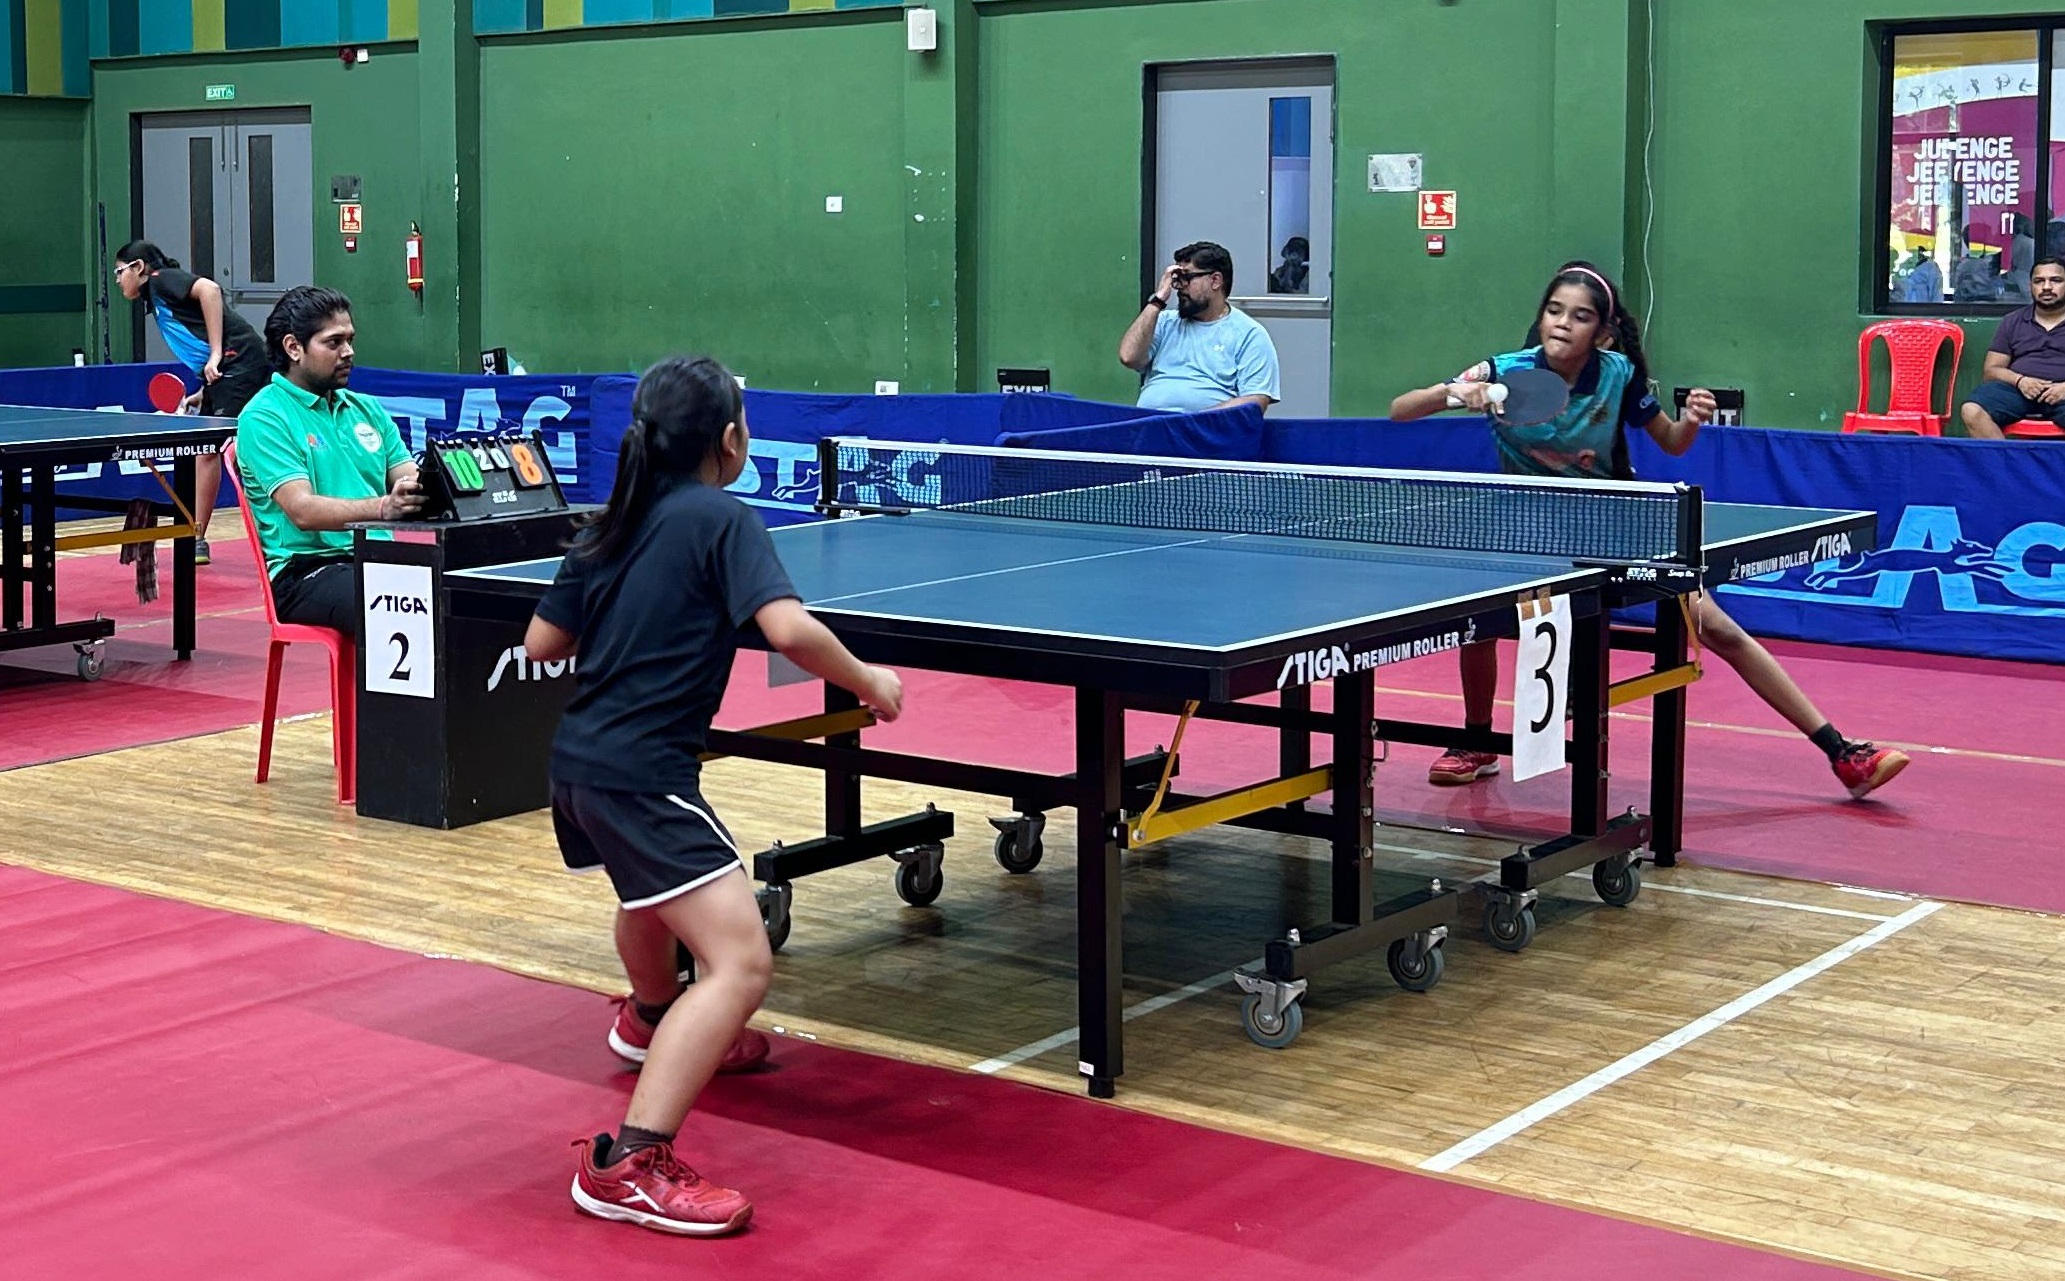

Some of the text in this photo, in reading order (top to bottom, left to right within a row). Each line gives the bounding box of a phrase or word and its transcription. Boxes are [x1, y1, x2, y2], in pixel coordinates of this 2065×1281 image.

[207, 87, 227, 98] EXIT
[1906, 183, 2019, 205] JEEENGE
[376, 388, 578, 469] TAG
[125, 445, 217, 460] PREMIUM ROLLER
[443, 451, 484, 490] 10
[512, 444, 543, 485] 8
[1740, 532, 1851, 579] PREMIUM ROLLER STIGA
[370, 595, 428, 614] STIGA
[389, 632, 412, 681] 2
[1277, 631, 1460, 689] STIGA PREMIUM ROLLER
[1530, 621, 1557, 733] 3
